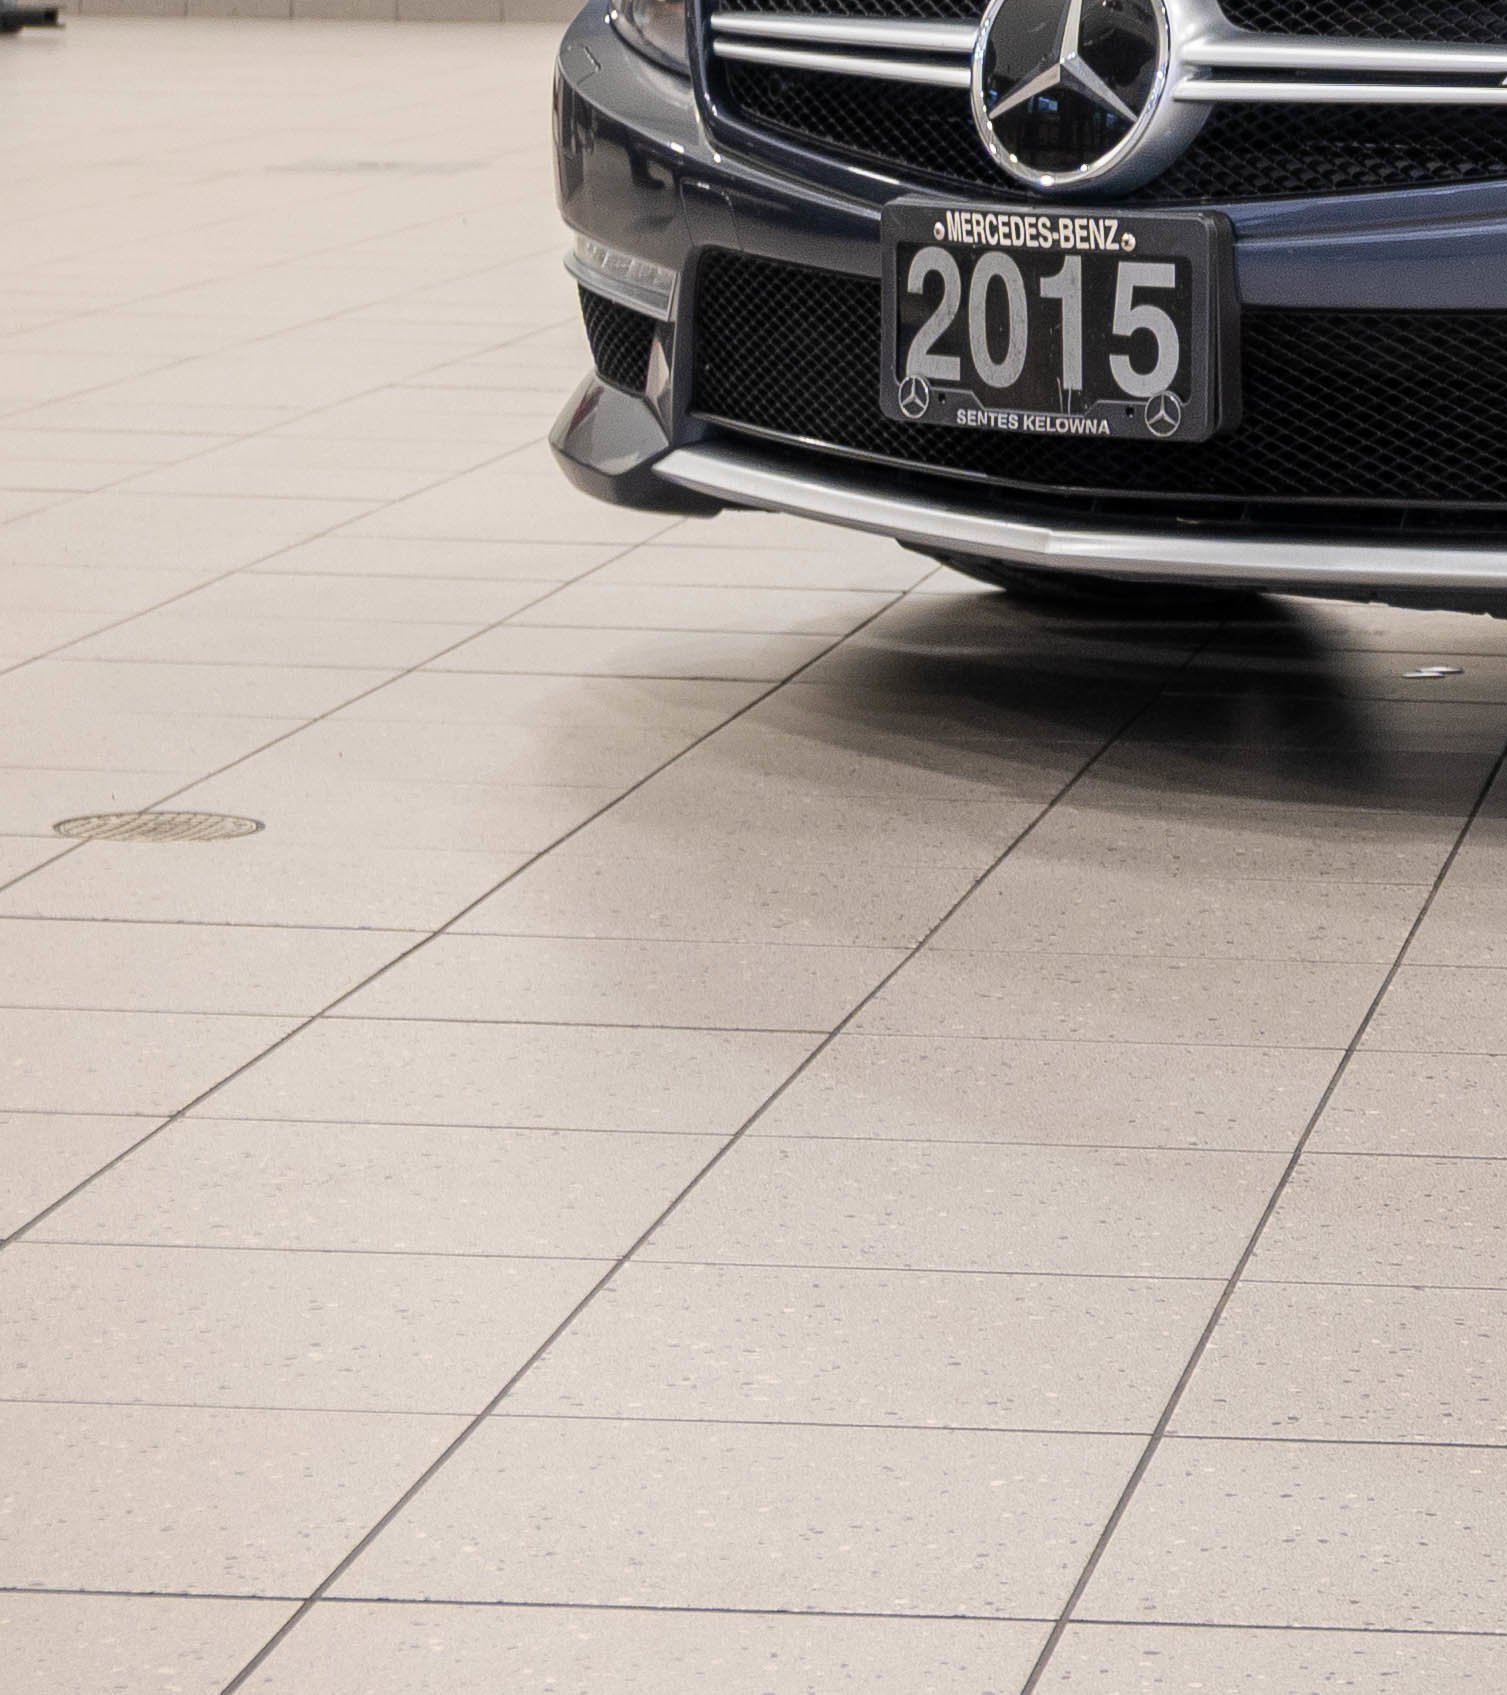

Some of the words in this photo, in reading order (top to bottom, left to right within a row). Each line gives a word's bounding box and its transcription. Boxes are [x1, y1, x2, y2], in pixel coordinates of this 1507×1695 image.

[945, 210, 1120, 251] MERCEDES-BENZ
[905, 245, 1180, 398] 2015
[956, 408, 1019, 431] SENTES
[1023, 414, 1111, 436] KELOWNA
